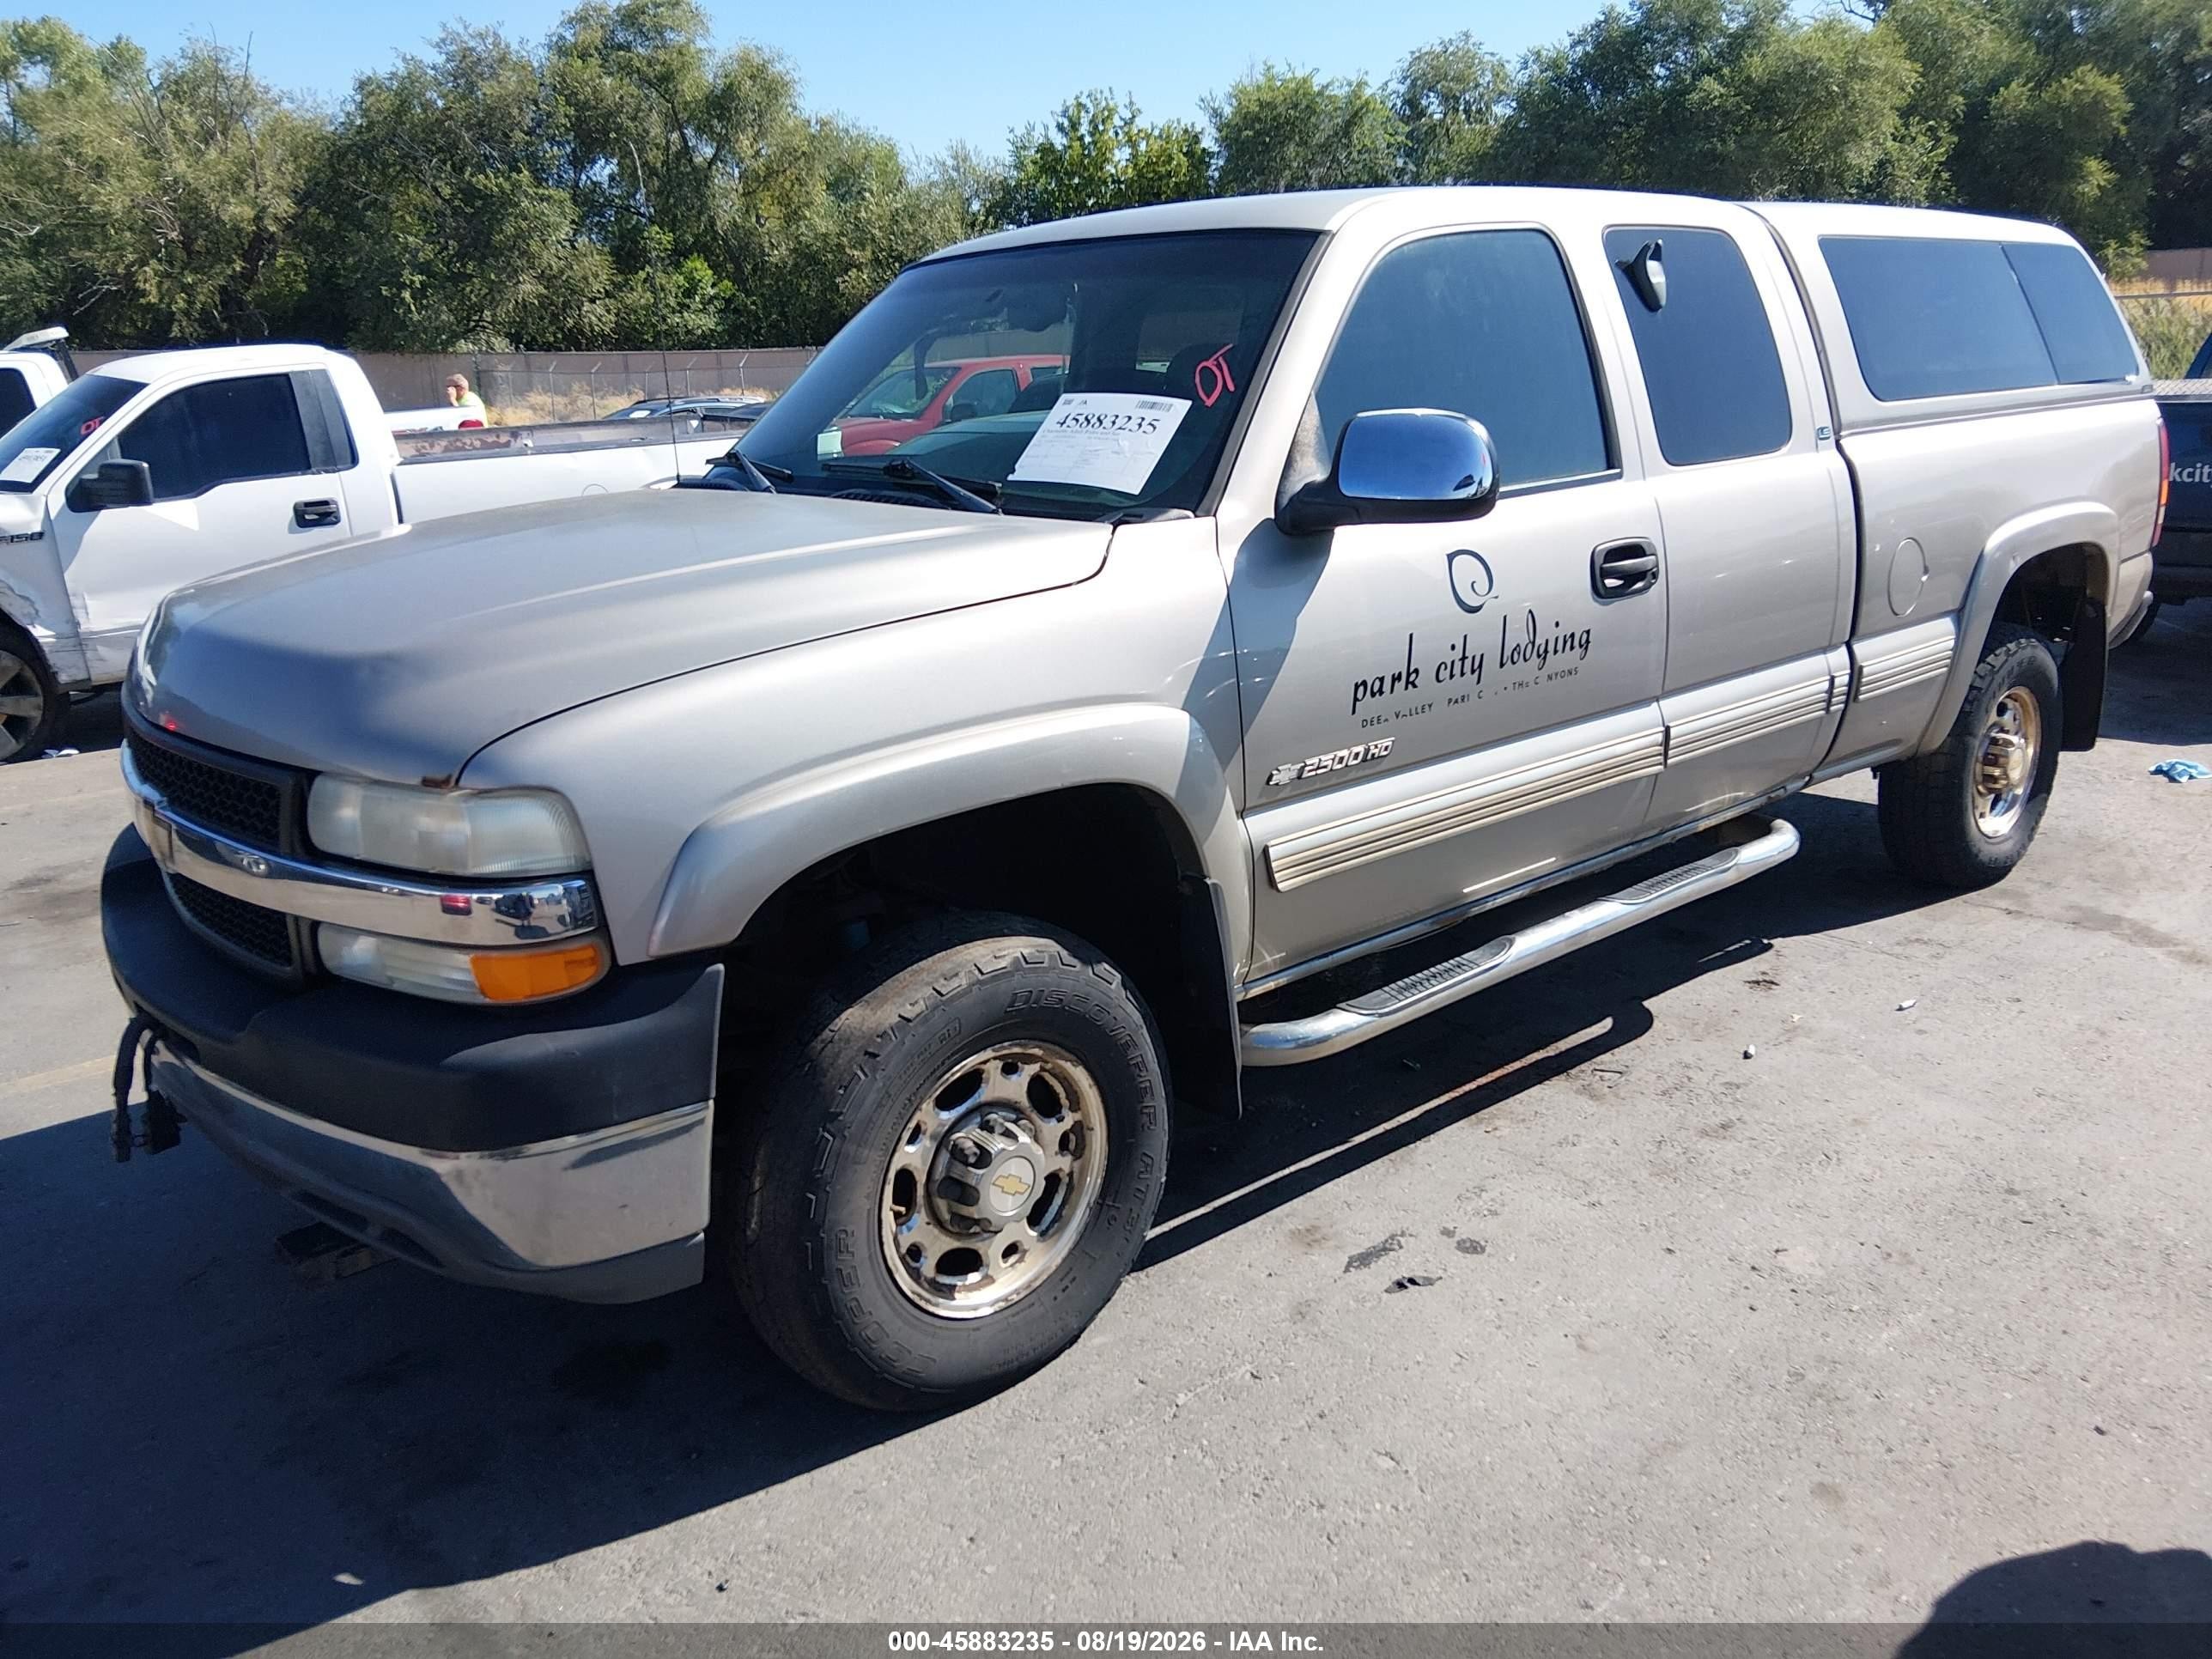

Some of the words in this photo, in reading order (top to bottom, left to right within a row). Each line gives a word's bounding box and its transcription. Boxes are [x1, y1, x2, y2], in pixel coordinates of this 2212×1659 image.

[1056, 412, 1162, 435] 45883235
[2169, 462, 2212, 489] kcit
[1351, 631, 1420, 716] park
[1435, 634, 1485, 686] city
[1534, 666, 1579, 686] CNYONS
[1301, 744, 1368, 779] 2500
[1365, 737, 1395, 761] HD
[1005, 988, 1158, 1133] DISCOVERER
[835, 1228, 938, 1377] COOPER
